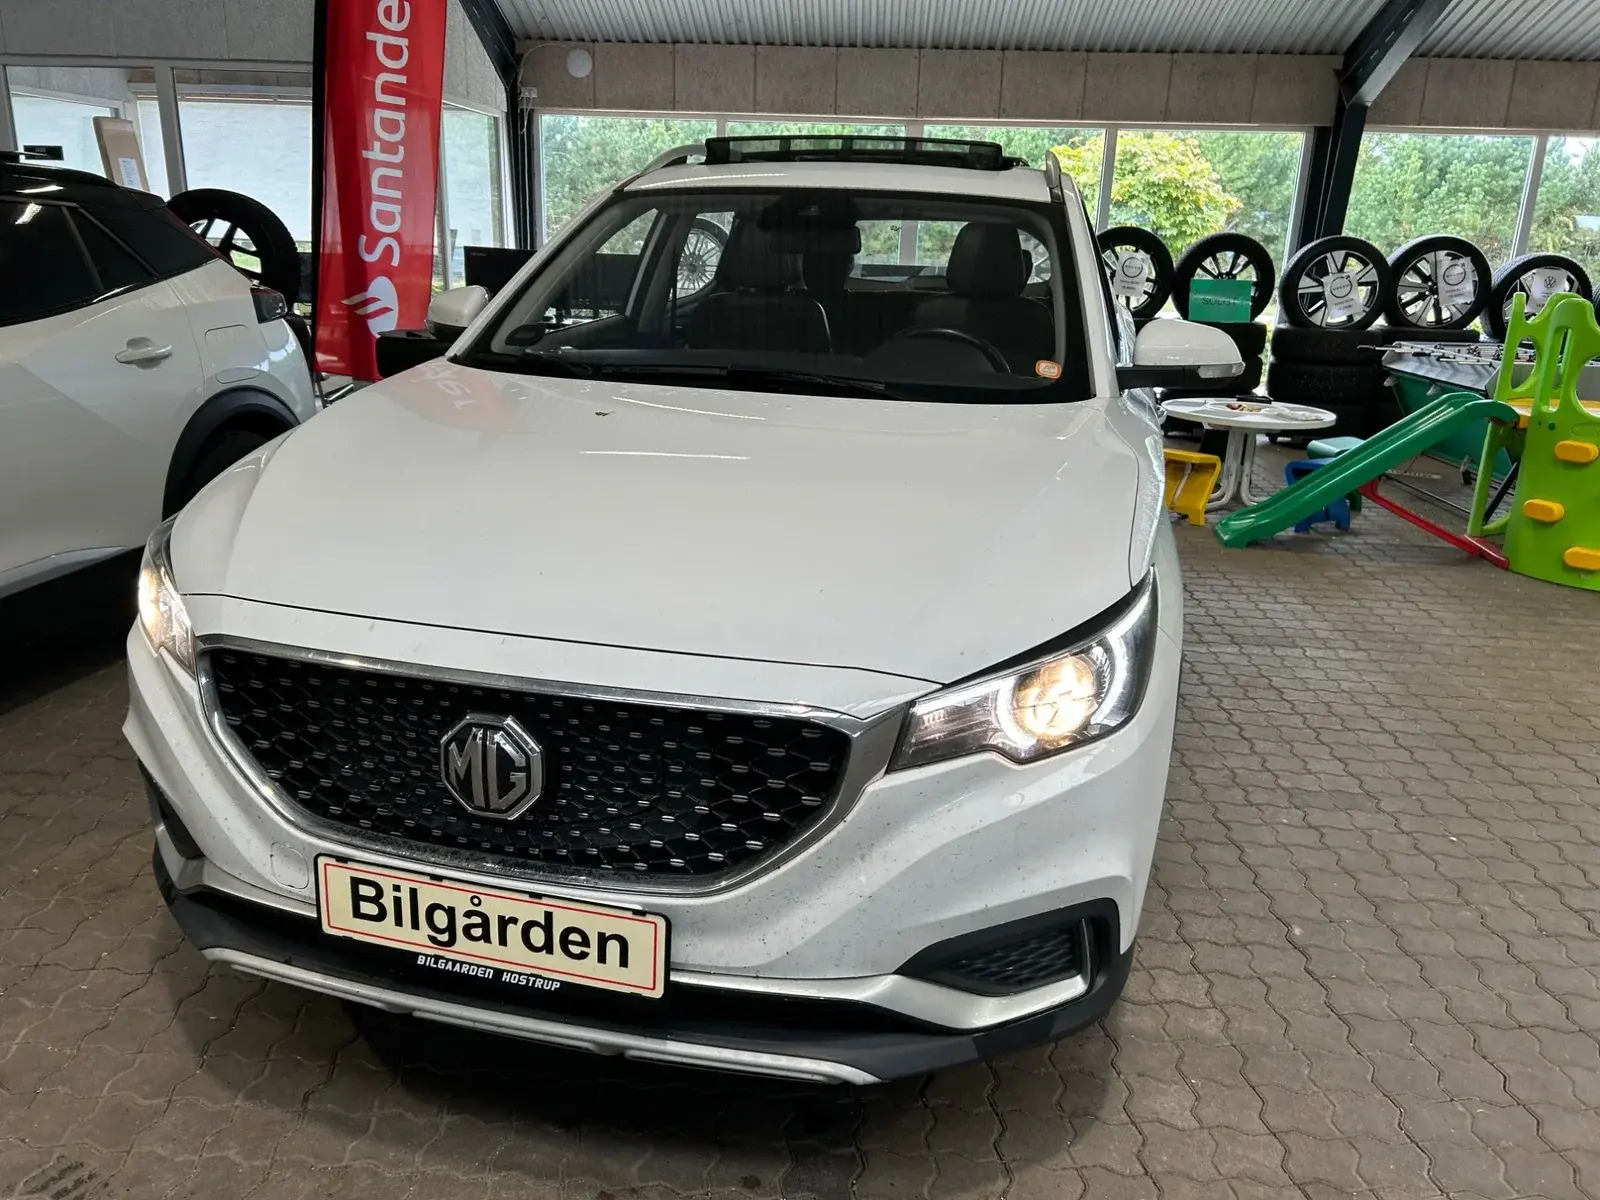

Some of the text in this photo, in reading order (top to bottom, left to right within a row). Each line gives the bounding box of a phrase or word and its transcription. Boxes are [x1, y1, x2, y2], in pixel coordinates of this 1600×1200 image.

[358, 0, 411, 267] Santande
[448, 727, 527, 809] MG
[349, 875, 630, 969] Bilgården
[416, 954, 561, 991] BILGAARDEN HOSTRUP
